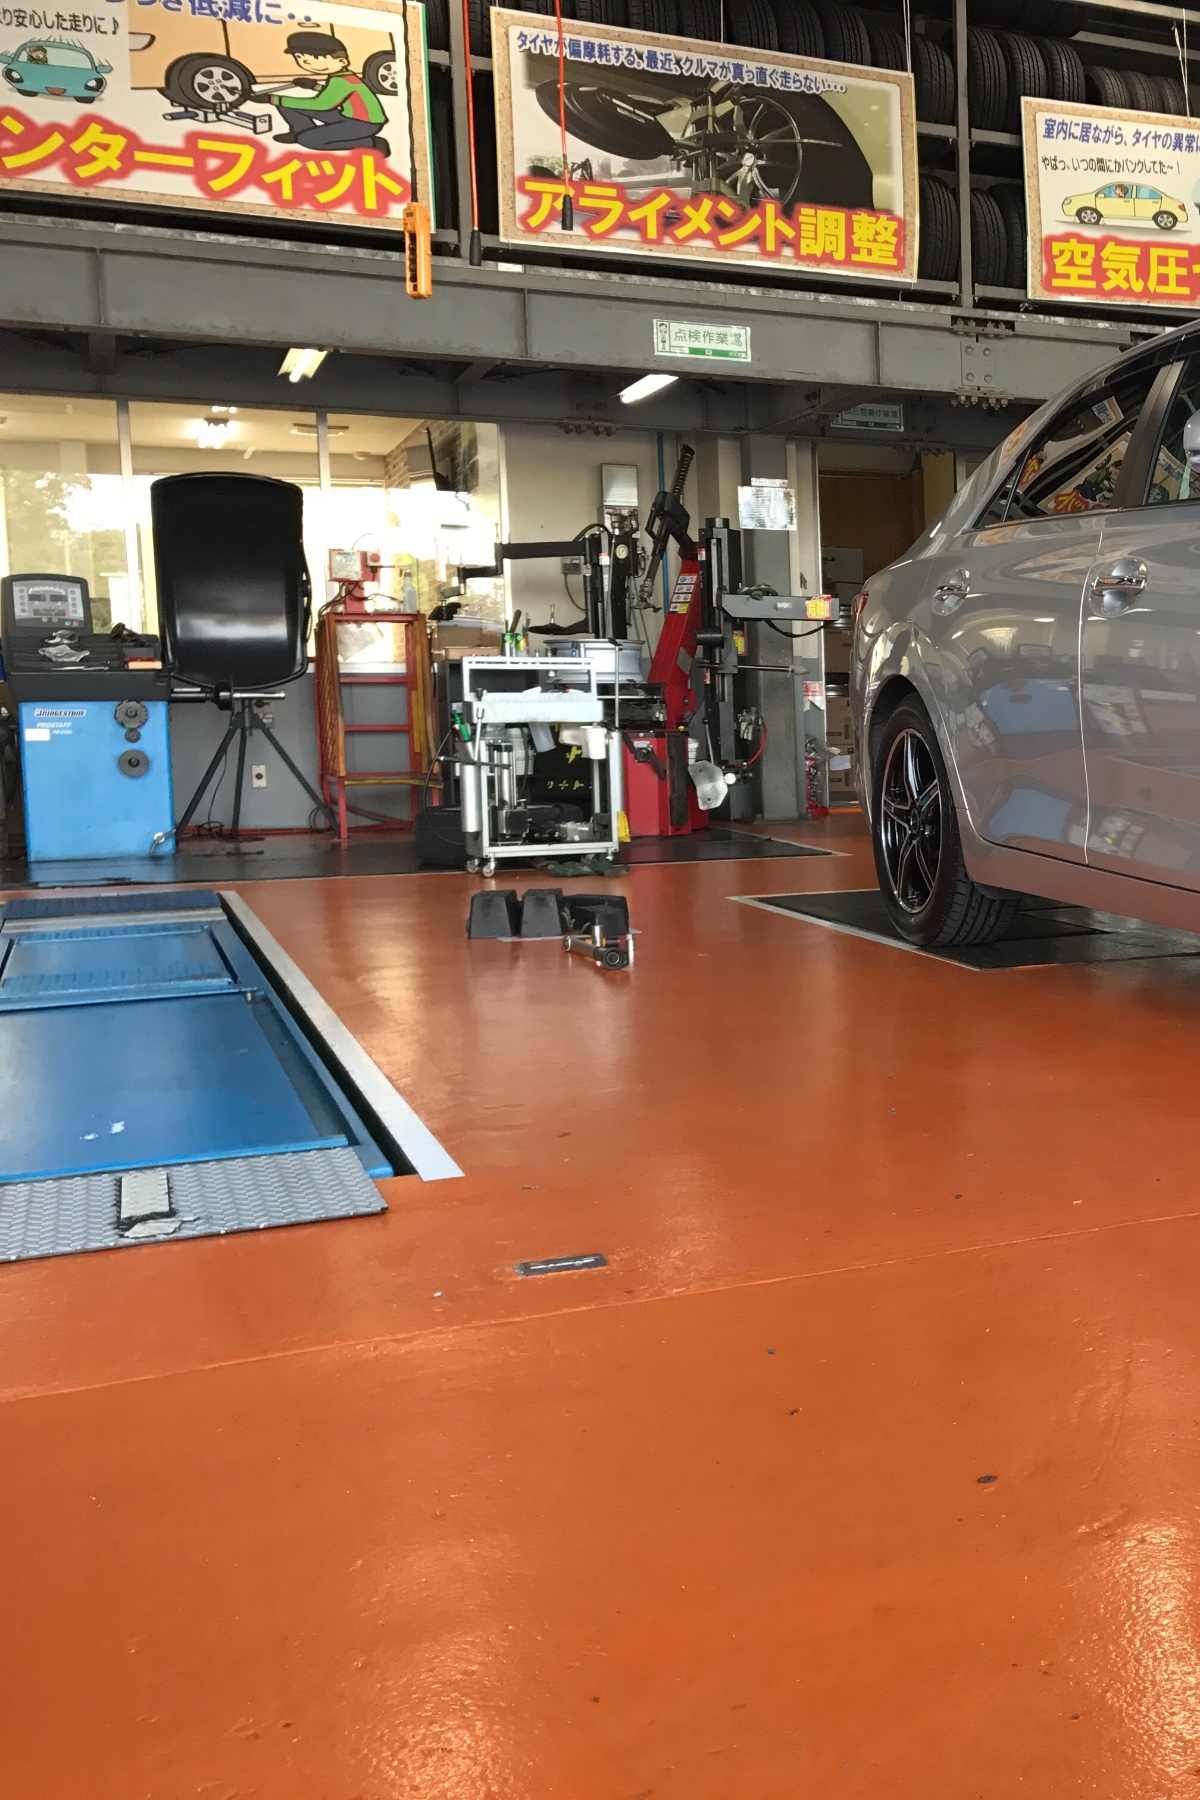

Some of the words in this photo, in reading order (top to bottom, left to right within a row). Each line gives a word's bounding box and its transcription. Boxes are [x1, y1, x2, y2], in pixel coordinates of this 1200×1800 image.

[524, 180, 899, 266] アライメント調整
[674, 328, 743, 347] 点検作業場
